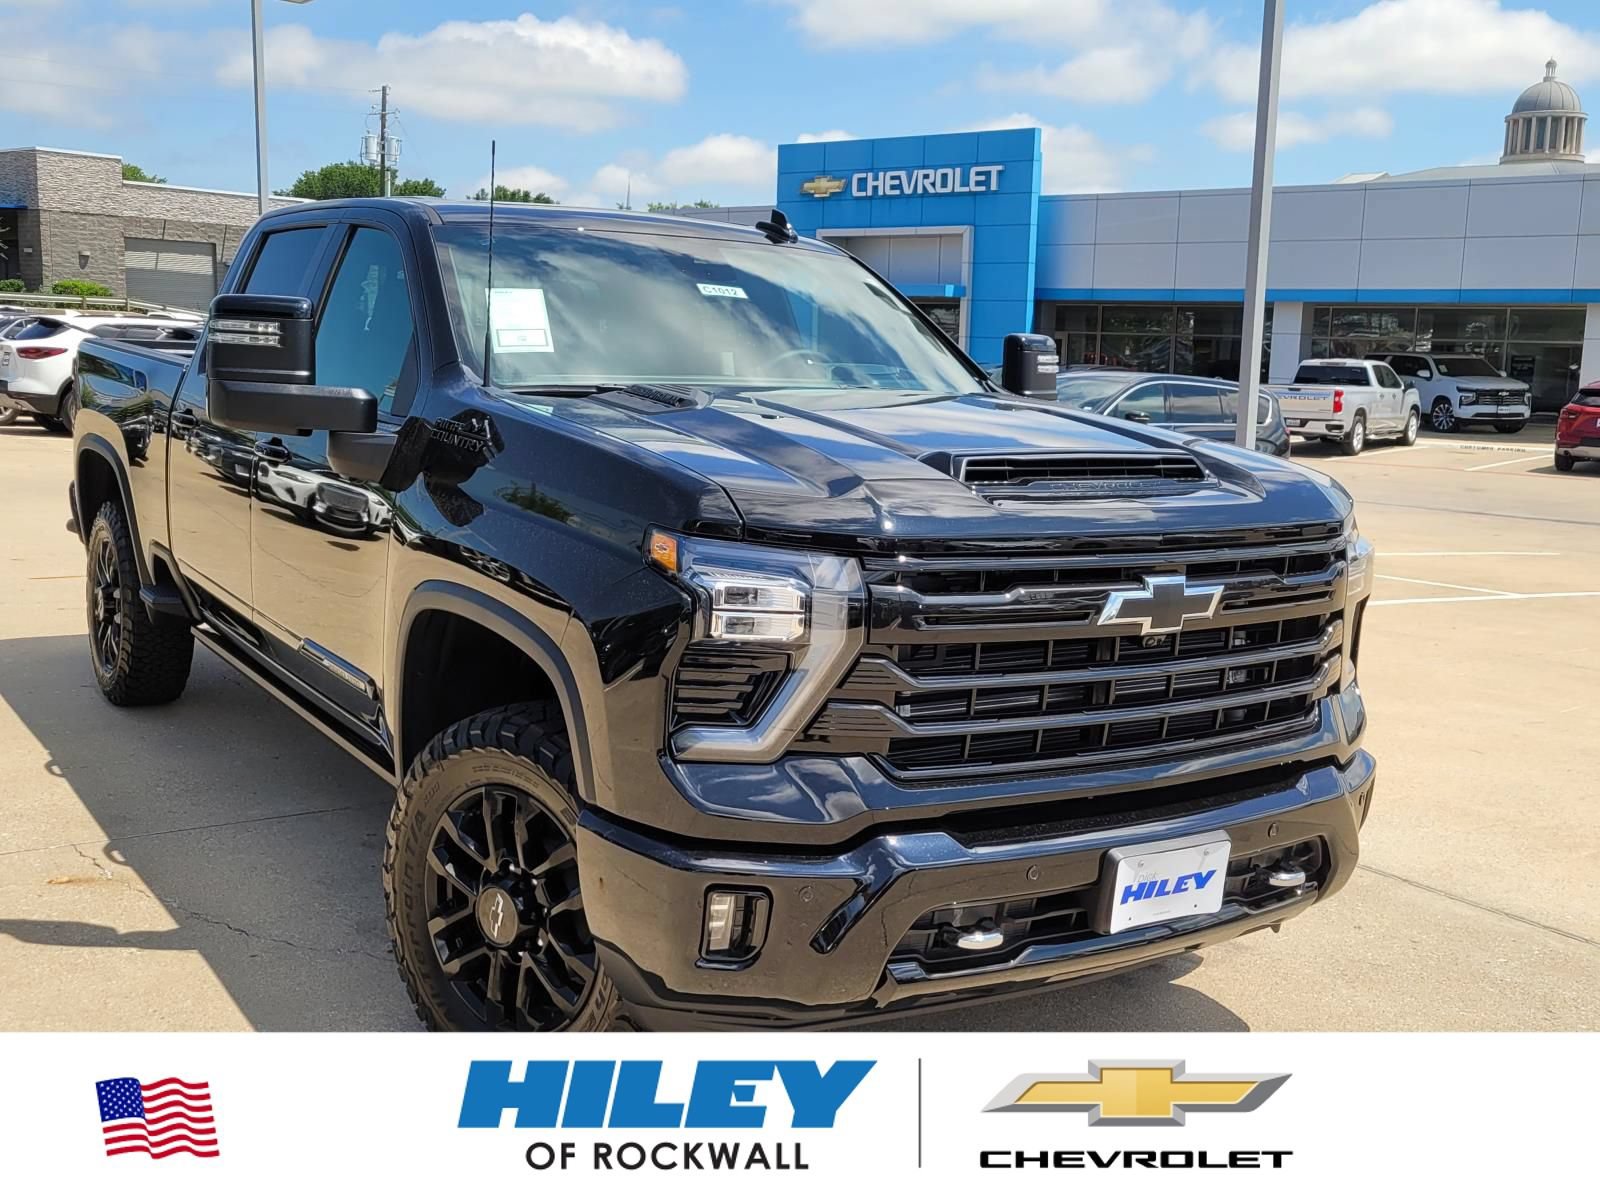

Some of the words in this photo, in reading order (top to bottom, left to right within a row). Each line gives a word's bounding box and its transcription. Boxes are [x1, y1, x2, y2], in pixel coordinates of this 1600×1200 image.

[852, 165, 1005, 197] CHEVROLET
[703, 286, 737, 296] C1012
[431, 429, 484, 452] COUNTRY
[1120, 869, 1217, 905] HILEY
